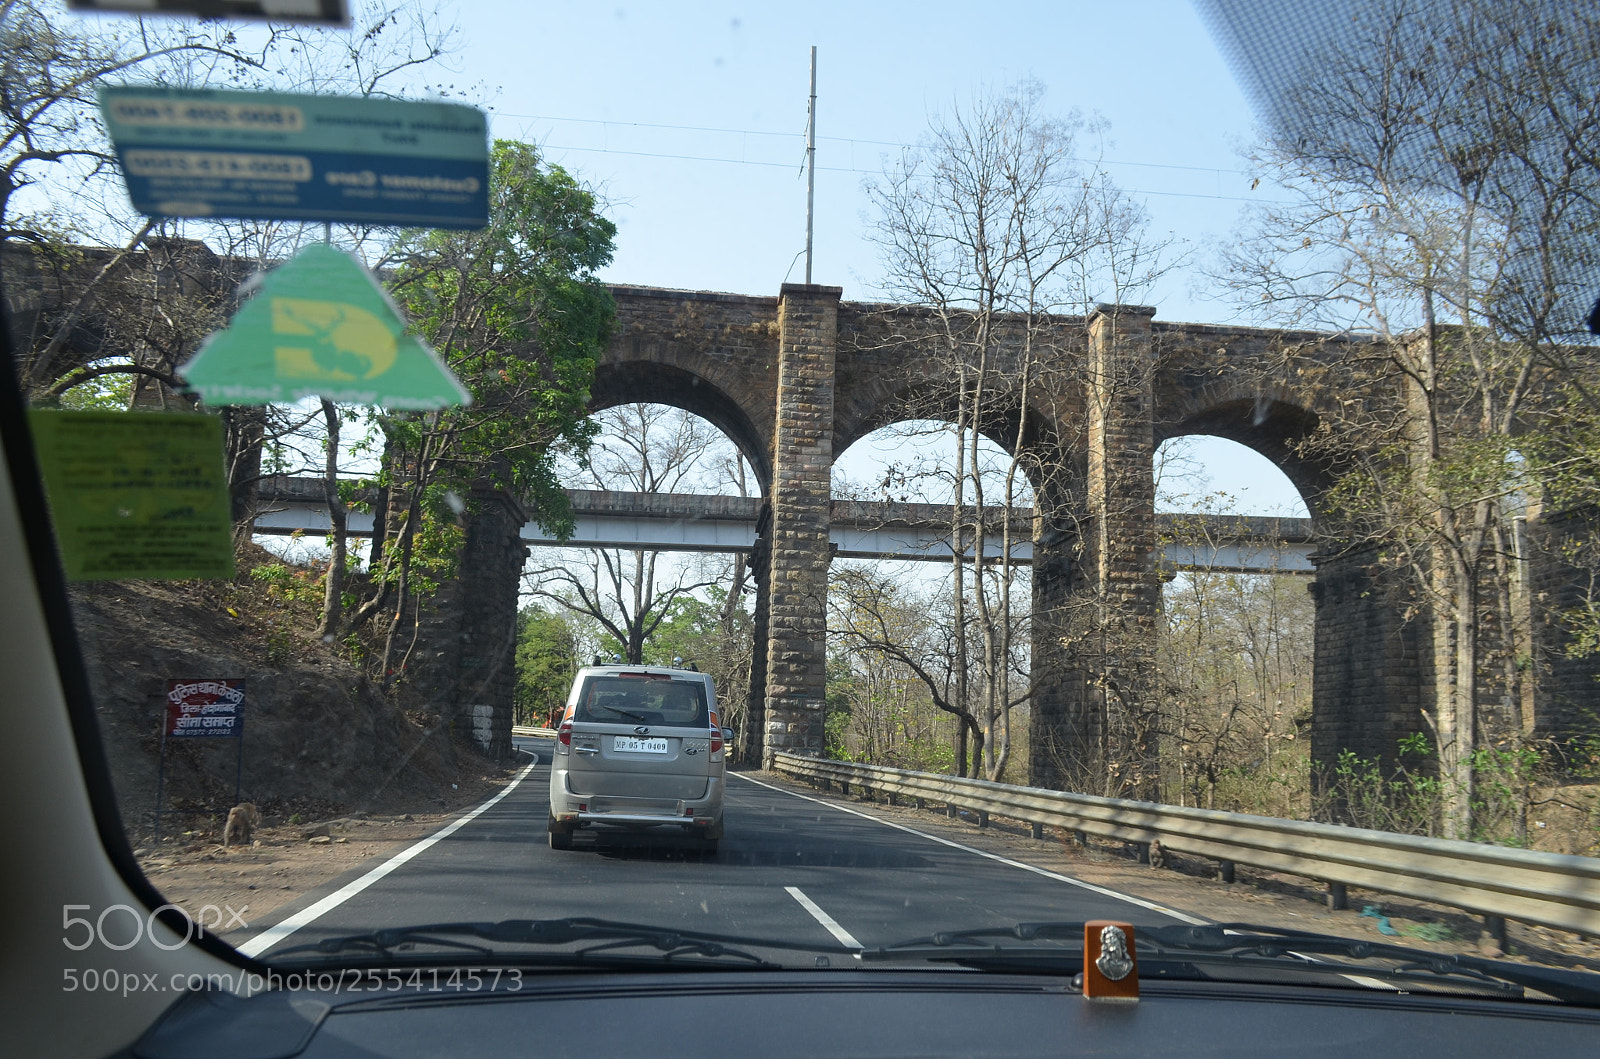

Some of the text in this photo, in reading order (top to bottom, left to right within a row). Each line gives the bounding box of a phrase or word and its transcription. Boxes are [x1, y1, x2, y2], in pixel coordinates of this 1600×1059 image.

[168, 684, 198, 704] पुलिस
[198, 682, 219, 695] थाना
[176, 713, 236, 728] सीमा समाप्त
[616, 741, 626, 749] MP
[641, 742, 646, 750] T
[648, 742, 666, 751] 0409
